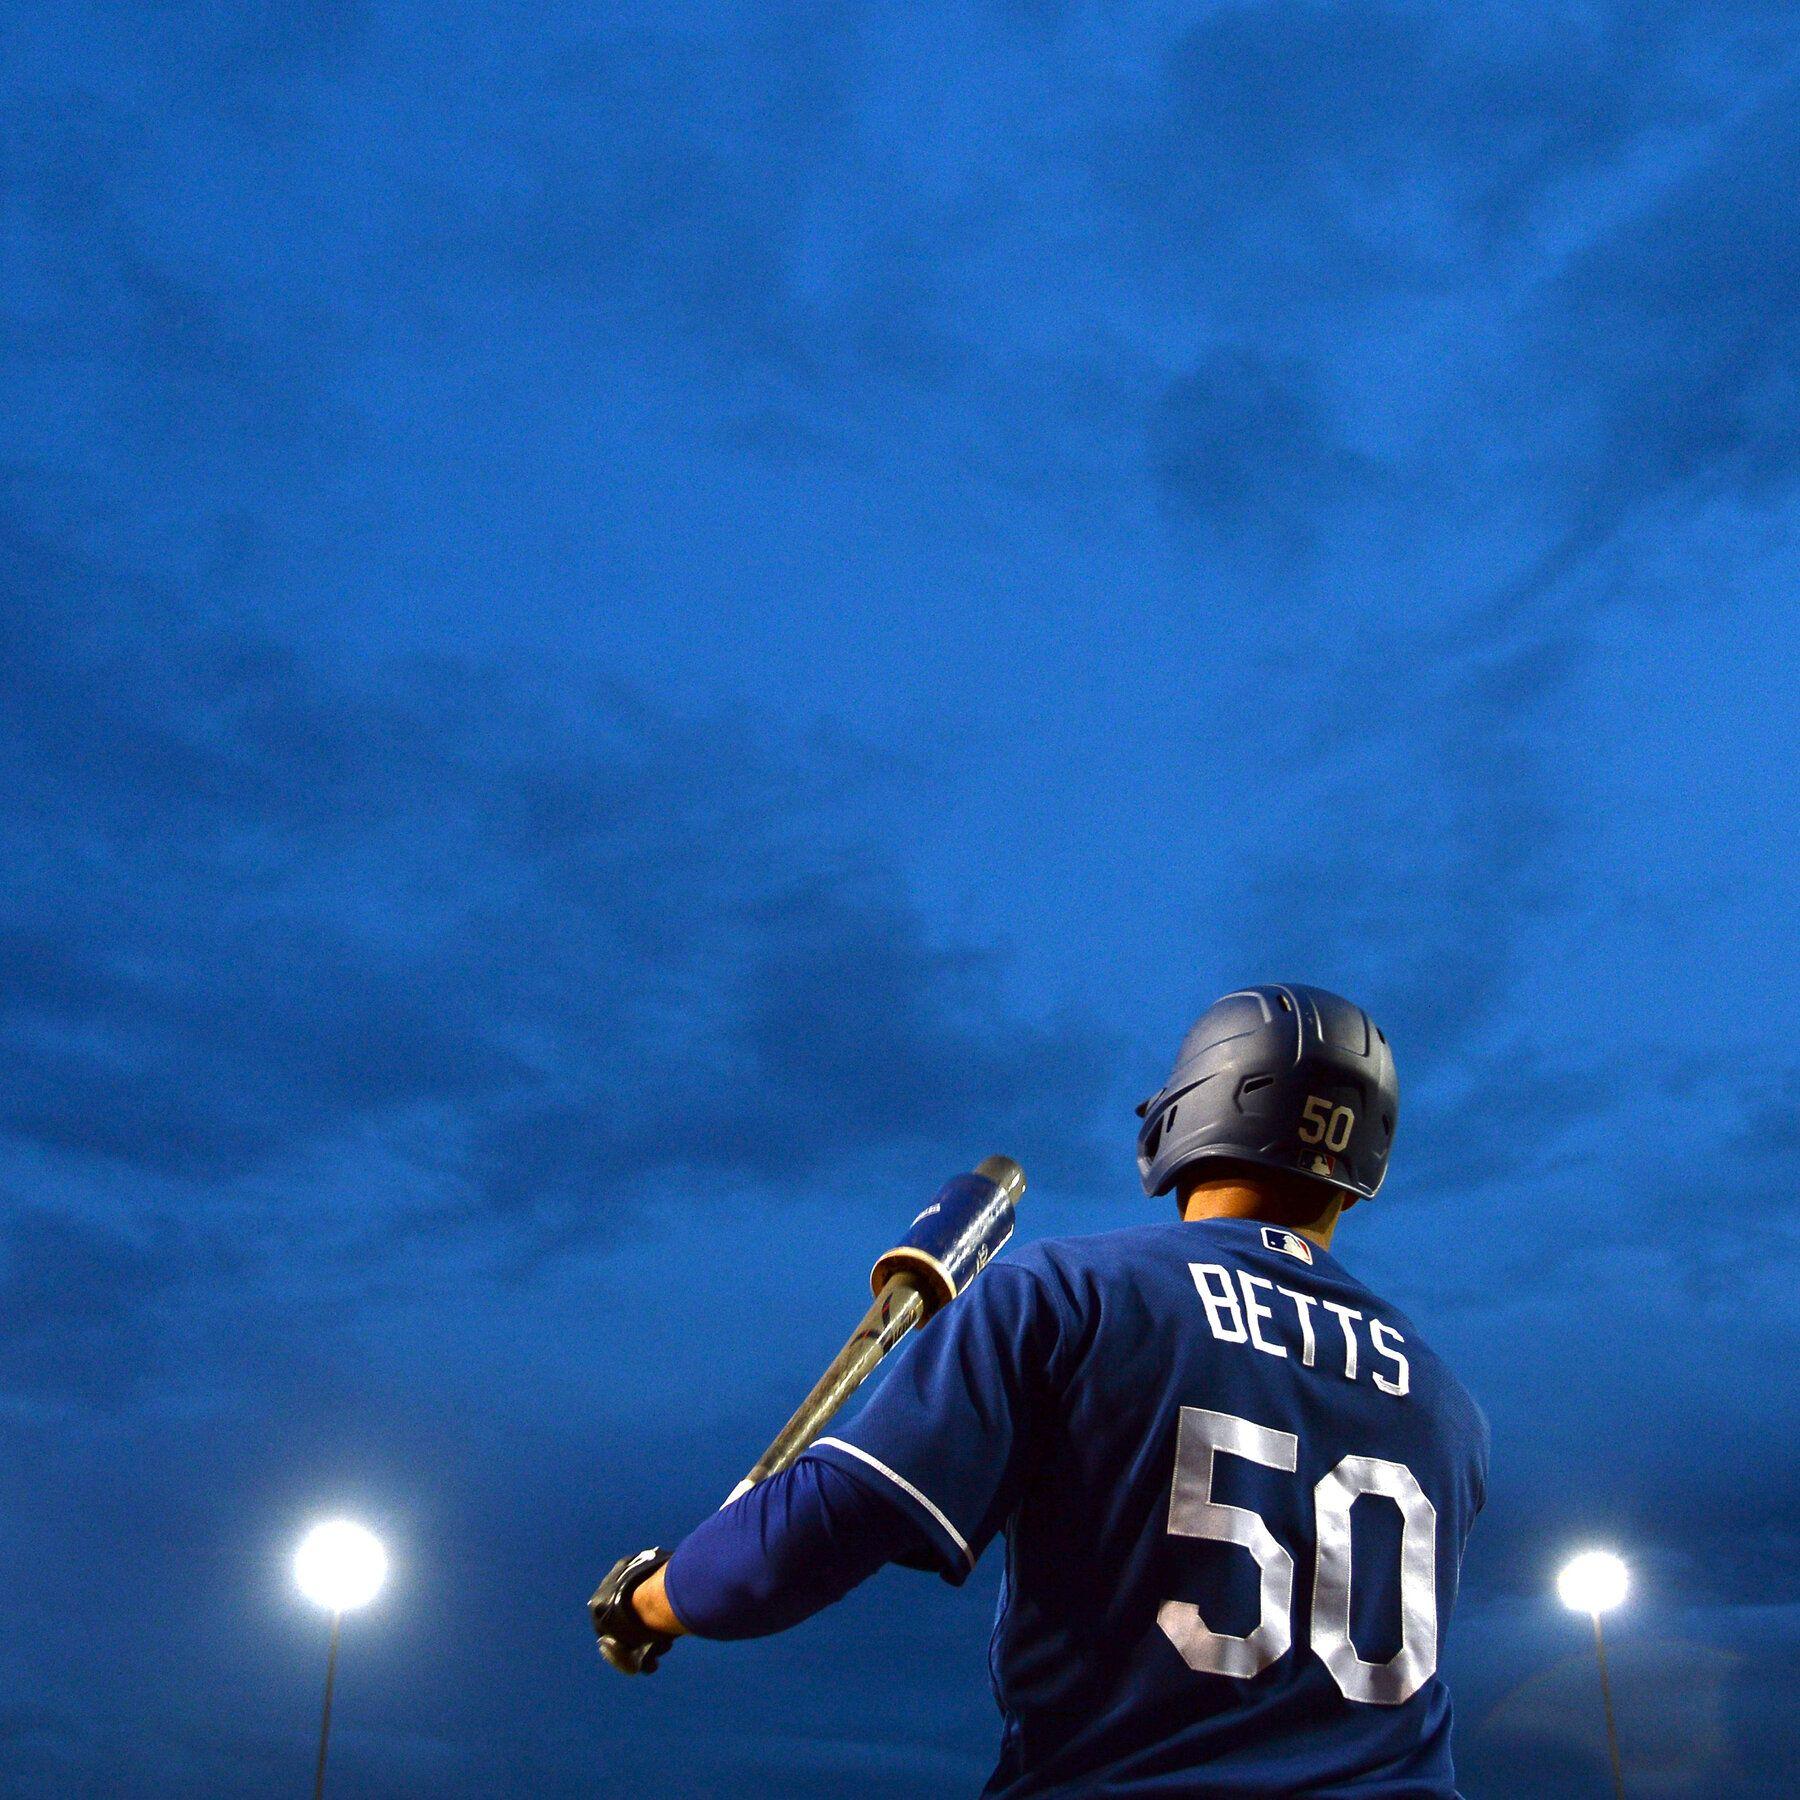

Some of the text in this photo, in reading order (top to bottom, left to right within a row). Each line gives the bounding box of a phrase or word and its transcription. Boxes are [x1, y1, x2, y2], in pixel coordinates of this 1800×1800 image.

[1299, 1095, 1355, 1153] 50
[1188, 1263, 1410, 1397] BETTS
[1156, 1406, 1437, 1705] 50
